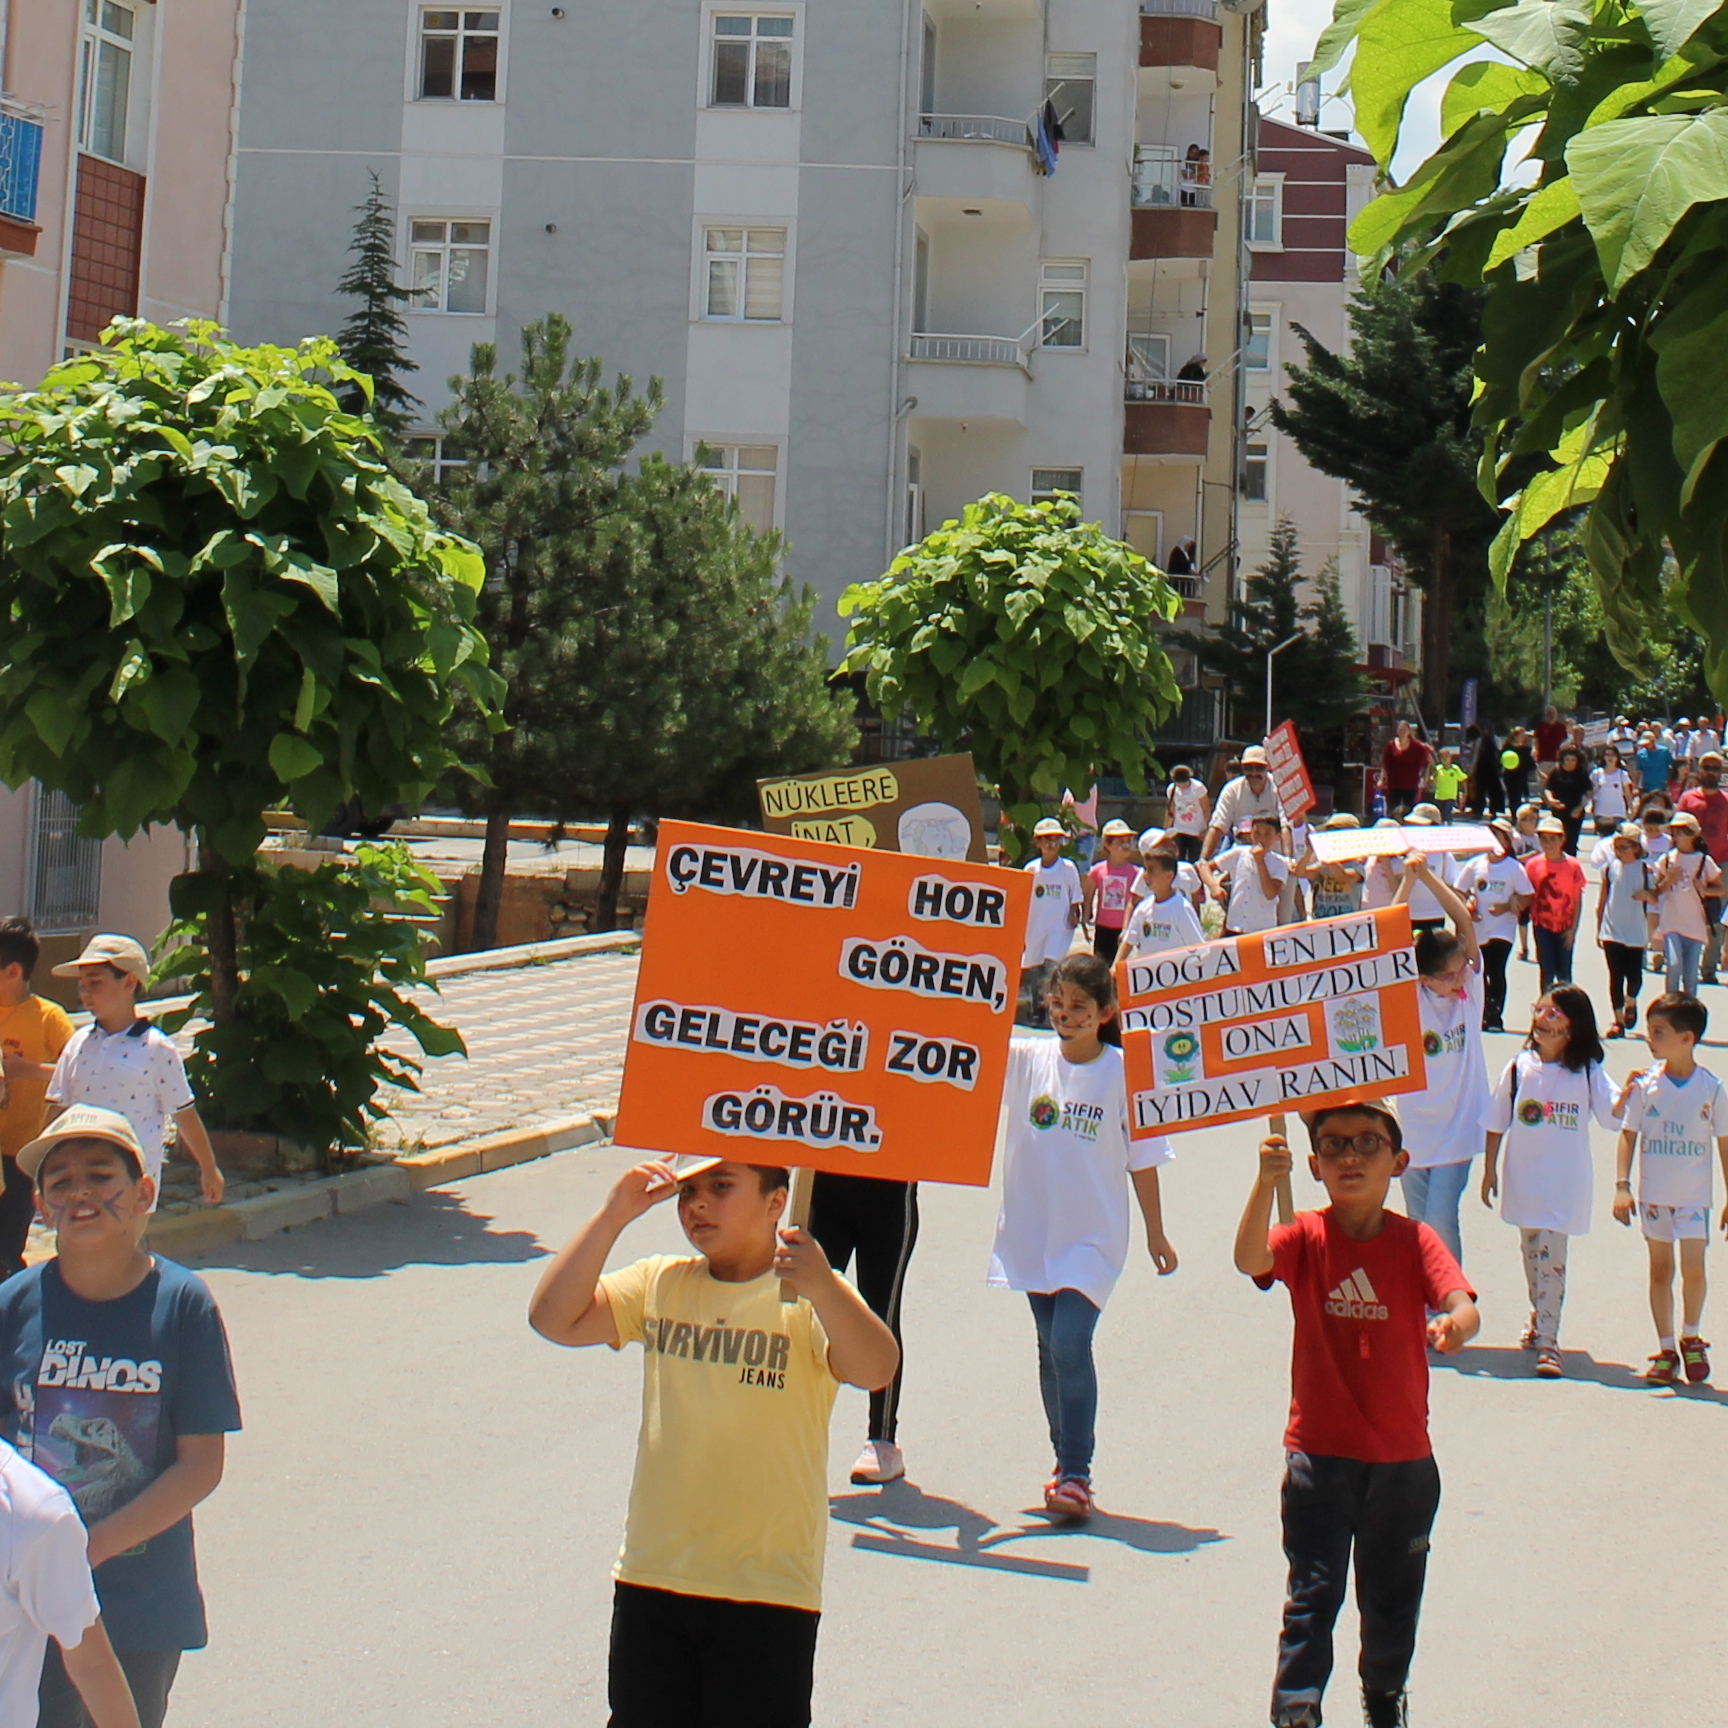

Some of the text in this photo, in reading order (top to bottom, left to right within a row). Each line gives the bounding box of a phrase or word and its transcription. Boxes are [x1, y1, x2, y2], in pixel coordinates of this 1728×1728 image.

[765, 775, 894, 813] NÜKLEERE
[669, 846, 1004, 925] ÇEVREYİ HOR
[1270, 933, 1315, 967] EN
[1327, 917, 1376, 956] İYİ
[847, 939, 1005, 1010] GÖREN,
[644, 1003, 977, 1081] GELECEĞİ ZOR
[1225, 1017, 1305, 1056] ONA
[711, 1087, 880, 1145] GÖRÜR.
[1061, 1115, 1101, 1136] ATIK
[1063, 1101, 1104, 1121] SIFIR
[1547, 1112, 1578, 1127] ATIK
[1663, 1120, 1685, 1137] Fly
[1325, 1300, 1389, 1320] adidas
[45, 1338, 88, 1357] LOST
[37, 1353, 163, 1394] DINOS
[739, 1367, 786, 1390] JEANS
